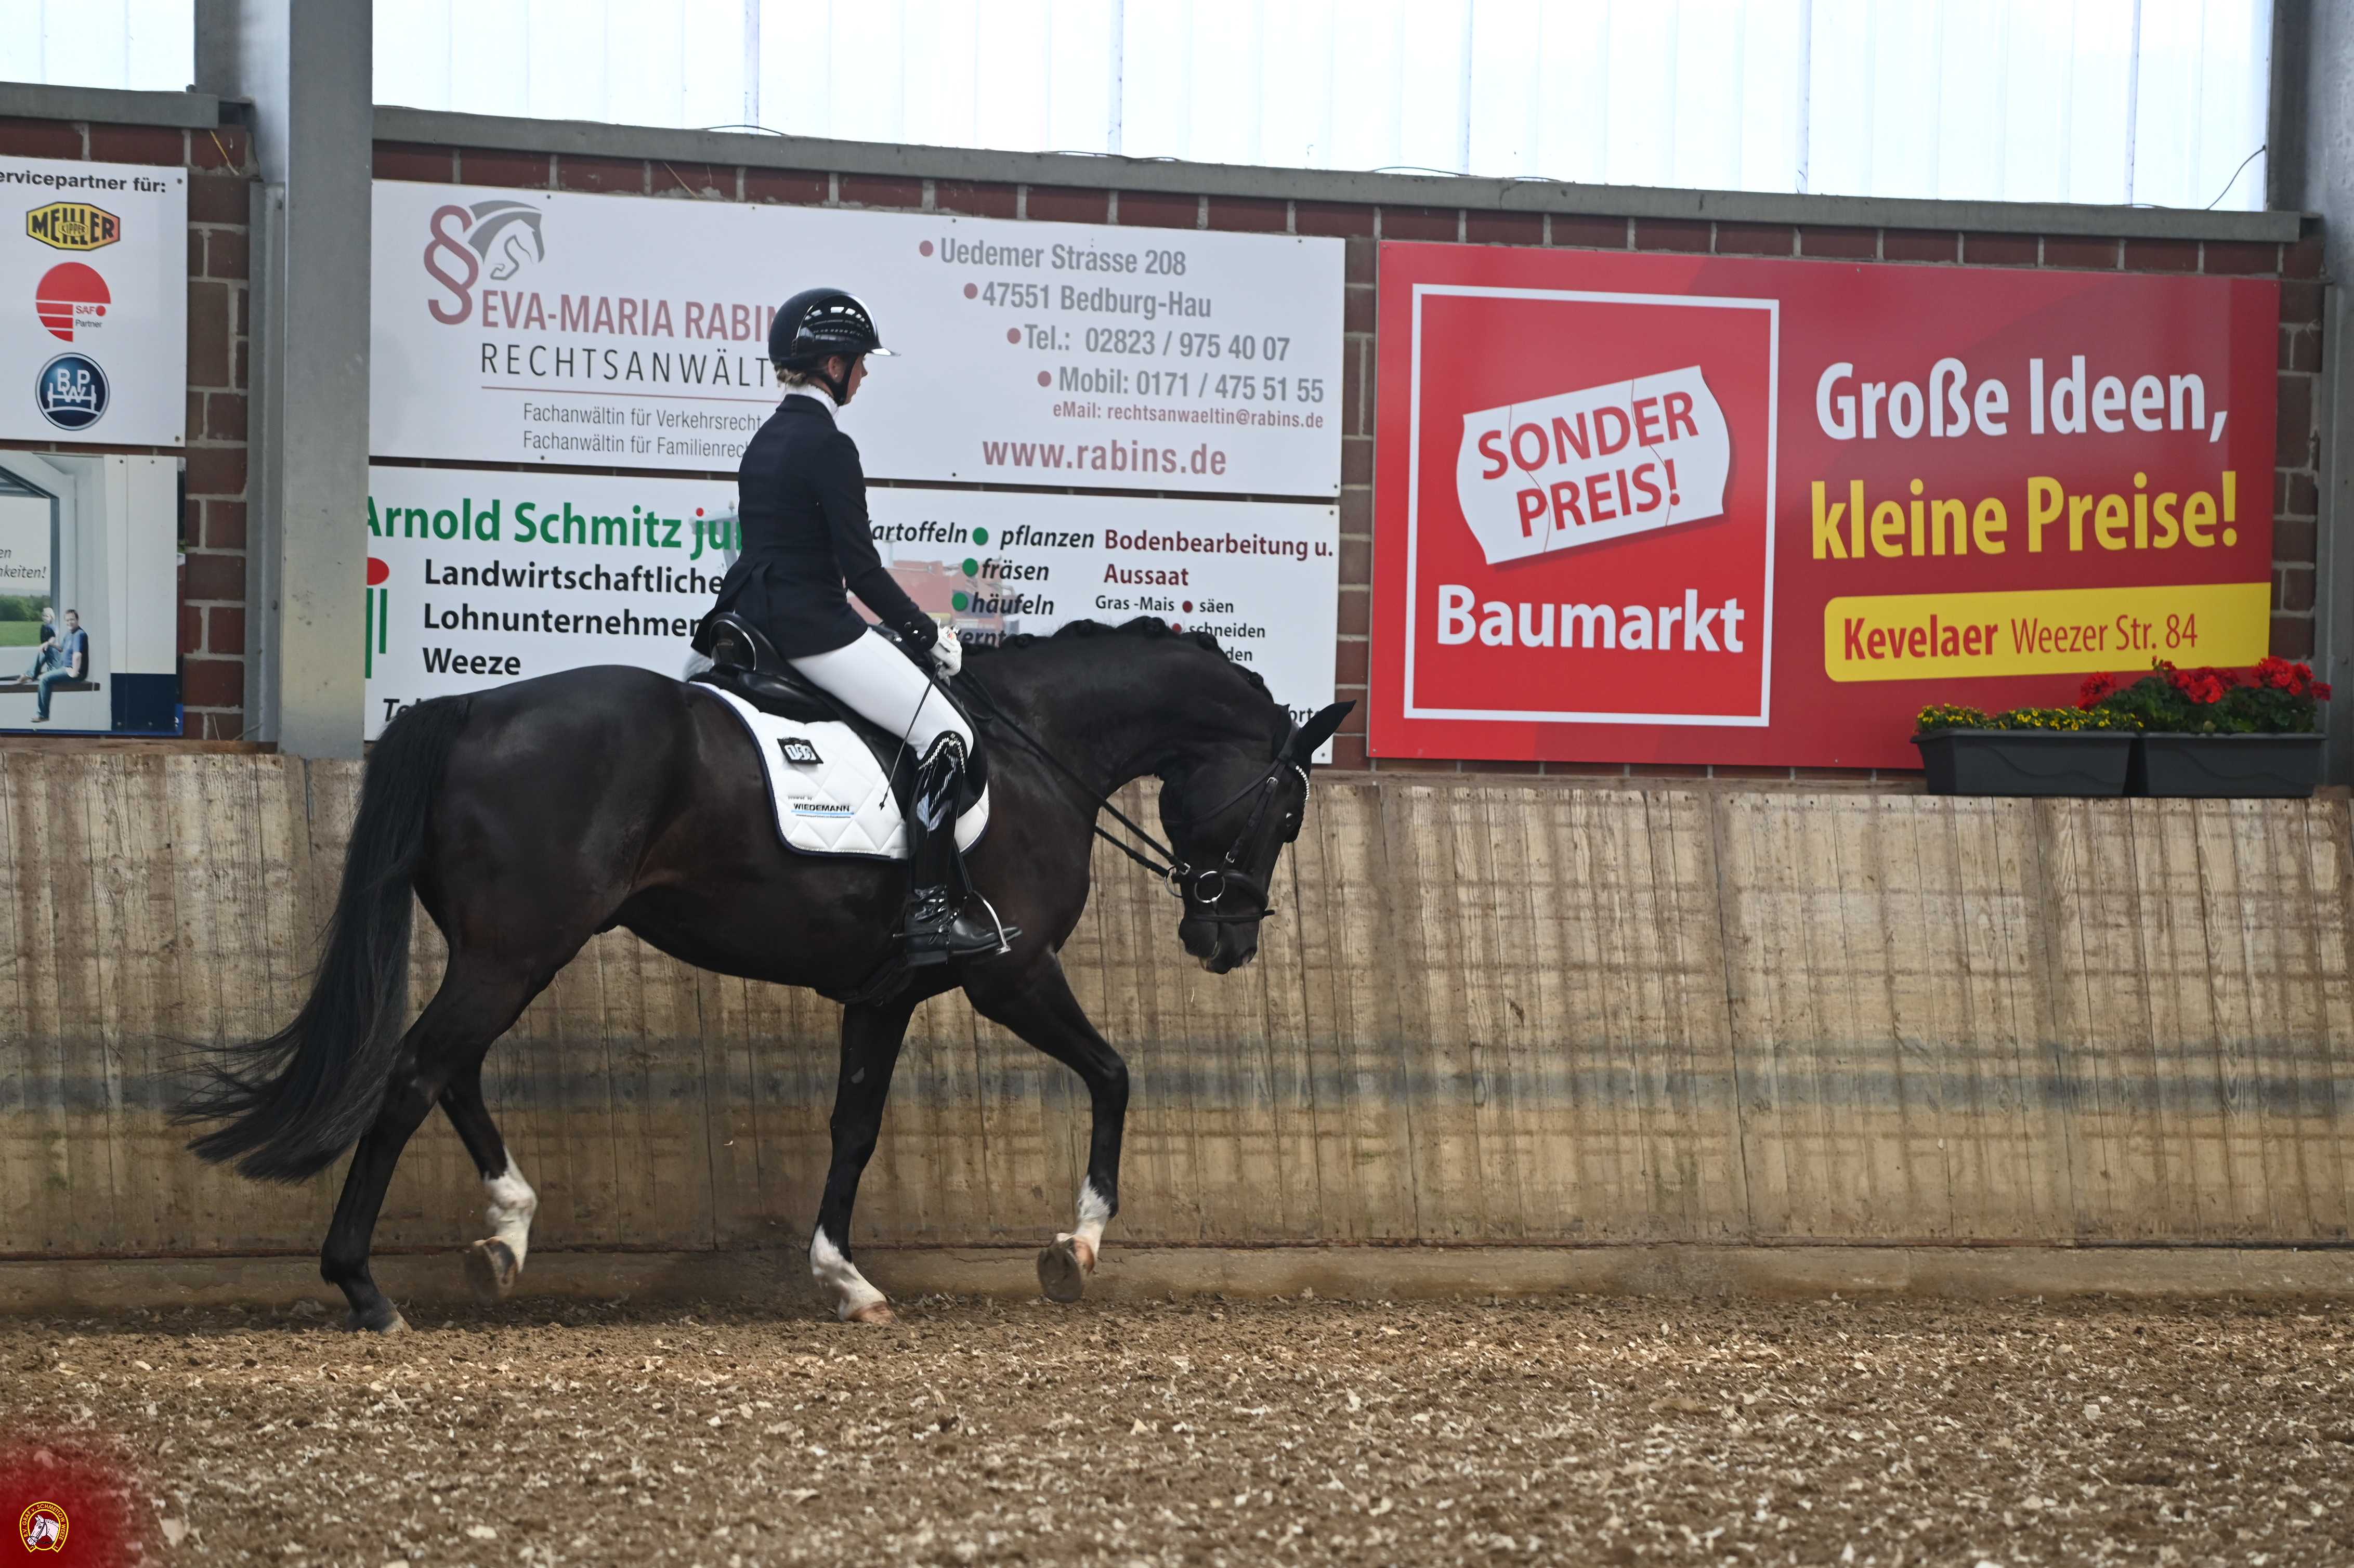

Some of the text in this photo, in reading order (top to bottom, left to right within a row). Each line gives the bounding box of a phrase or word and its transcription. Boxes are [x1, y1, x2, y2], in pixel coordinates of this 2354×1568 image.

[133, 177, 165, 193] für:
[32, 208, 115, 245] MEILLER
[62, 223, 86, 234] KIPPER
[941, 238, 1186, 276] Uedemer Strasse 208
[76, 306, 95, 315] SAF
[482, 290, 774, 342] EVA-MARIA RABI
[983, 281, 1211, 320] 47551 Bedburg-Hau
[75, 319, 102, 328] Partner
[1024, 324, 1290, 361] Tel.: 02823 / 975 40 07
[481, 342, 770, 387] RECHTSANWÄLT
[1060, 367, 1324, 403] Mobil: 0171 / 475 51 55
[1815, 355, 2229, 443] Große Ideen,
[524, 403, 761, 431] Fachanwältin für Verkehrsrecht
[1053, 401, 1323, 428] eMail: rechtsanwaeltin@rabins.de
[524, 430, 749, 458] Fachanwältin für Familienrec
[1477, 390, 1699, 480] SONDER
[983, 439, 1226, 475] www.rabins.de
[1515, 458, 1681, 538] PREIS!
[367, 496, 500, 541] Arnold
[514, 502, 681, 548] Schmitz
[1810, 470, 2238, 560] kleine Preise!
[870, 520, 1094, 550] artoffeln pflanzen
[1105, 529, 1332, 561] Bodenbearbeitung u.
[425, 559, 723, 594] Landwirtschaftliche
[982, 558, 1049, 582] fräsen
[1104, 564, 1188, 586] Aussaat
[971, 591, 1054, 616] häufeln
[1095, 595, 1129, 610] Gras
[1199, 599, 1234, 613] säen
[1436, 583, 1745, 654] Baumarkt
[1189, 622, 1265, 638] schneiden
[1843, 615, 2199, 662] Kevelaer Weezer Str. 84
[423, 647, 520, 675] Weeze
[794, 803, 849, 812] WIEDEMANN
